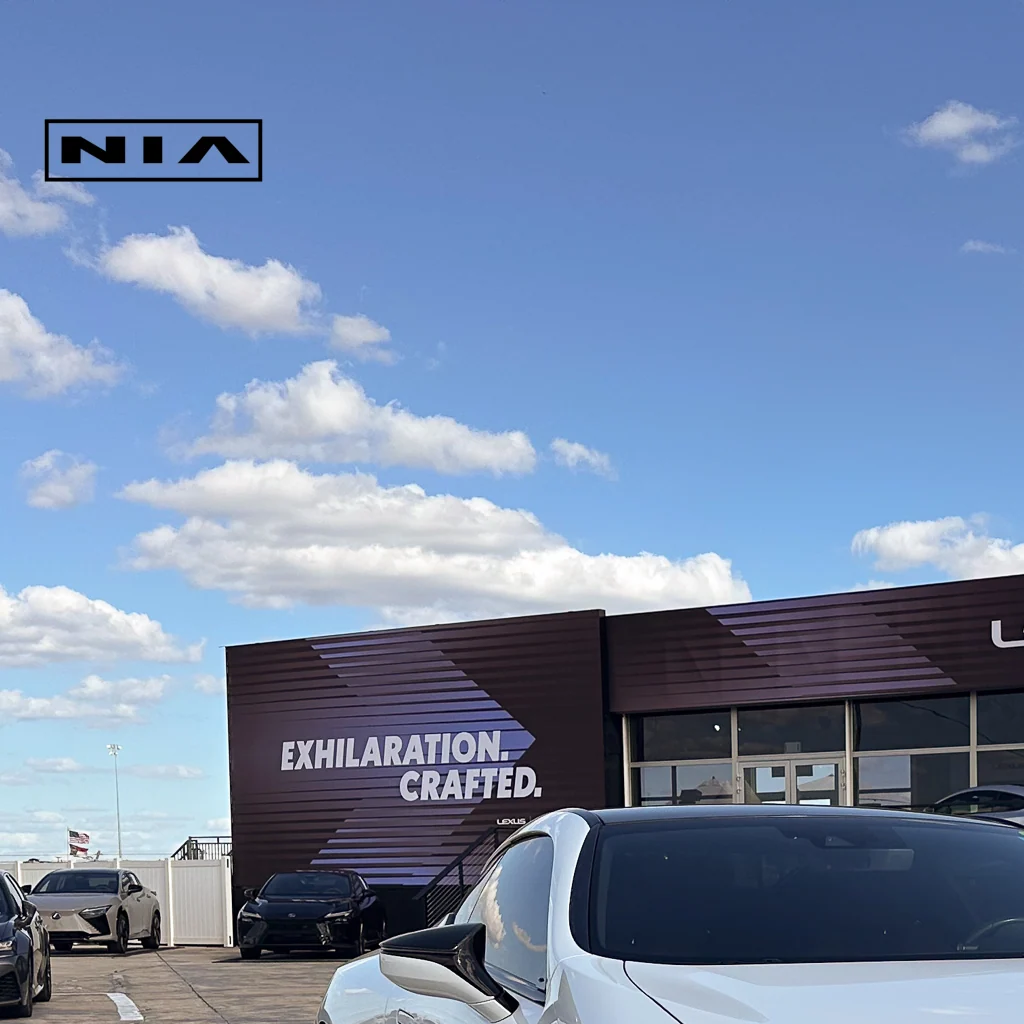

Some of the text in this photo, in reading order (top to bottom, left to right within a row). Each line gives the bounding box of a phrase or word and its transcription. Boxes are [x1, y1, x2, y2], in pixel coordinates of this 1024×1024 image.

[281, 731, 508, 770] EXHILARATION.
[400, 766, 542, 801] CRAFTED.
[496, 818, 526, 826] LEXUS
